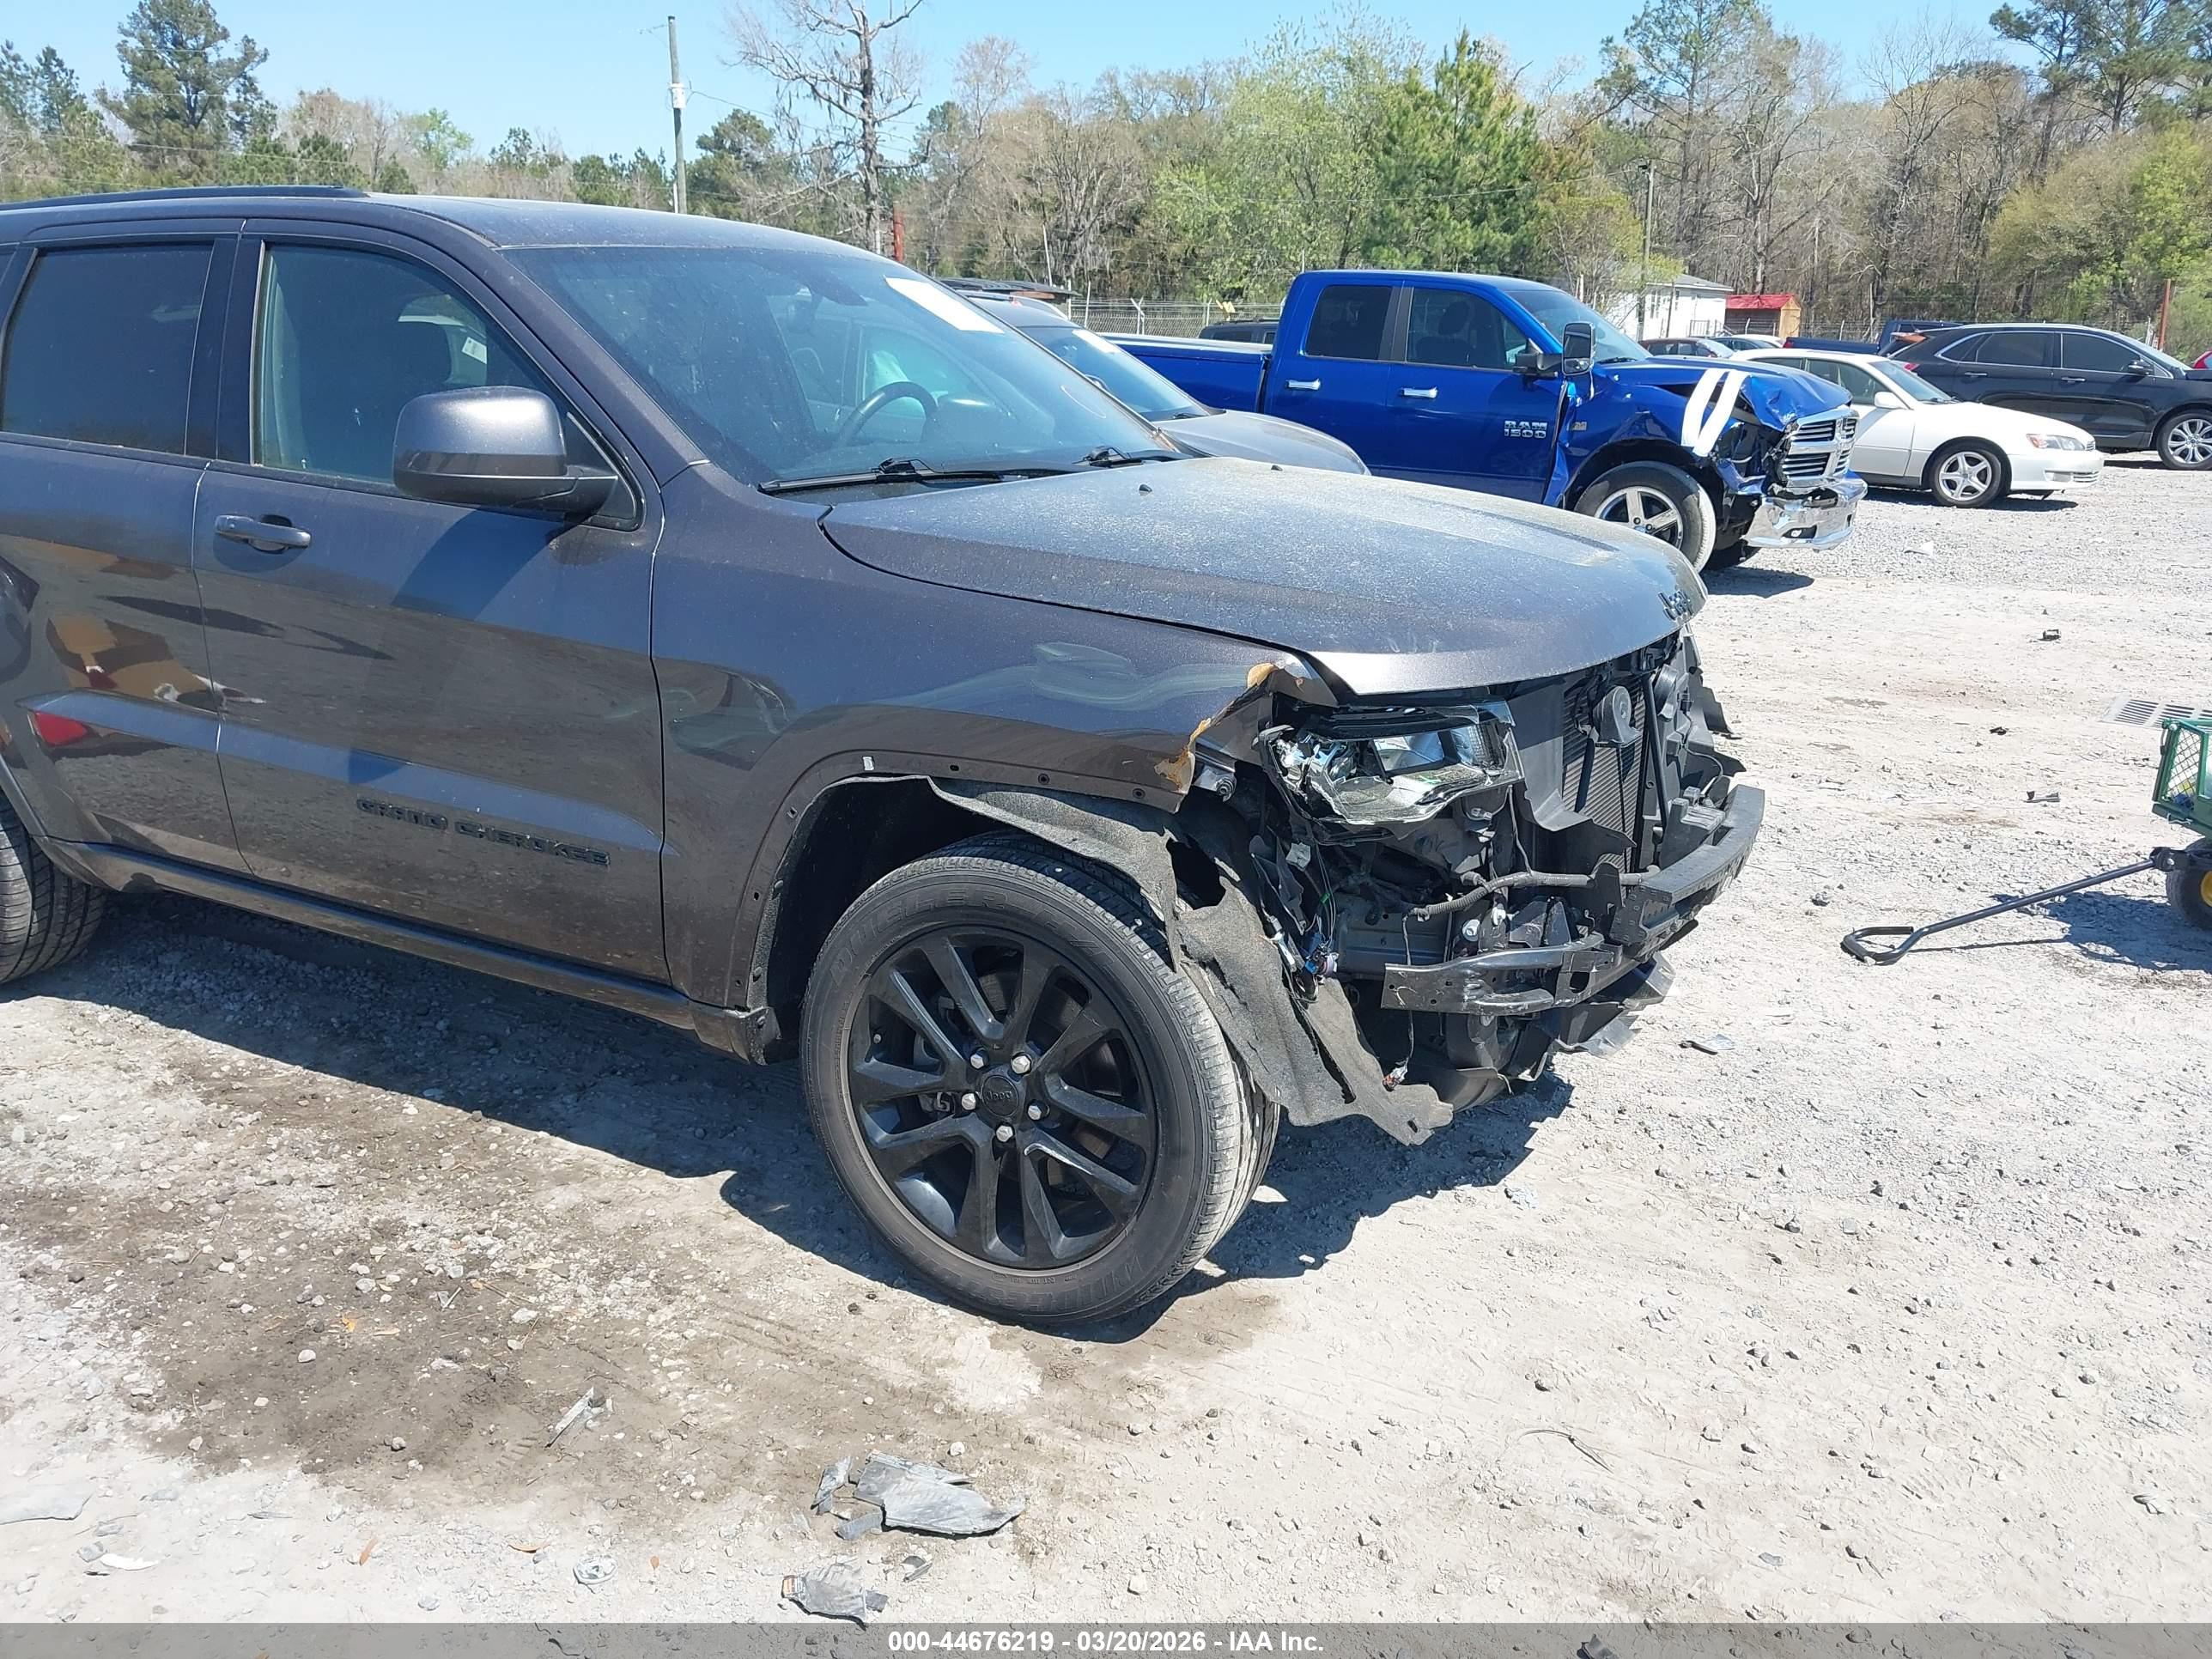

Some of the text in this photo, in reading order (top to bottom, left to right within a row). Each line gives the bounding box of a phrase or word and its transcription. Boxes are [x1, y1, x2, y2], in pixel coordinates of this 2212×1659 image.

[1504, 420, 1547, 430] RAM
[1504, 428, 1547, 439] 1500
[356, 797, 611, 866] GRAND CHEROKEE
